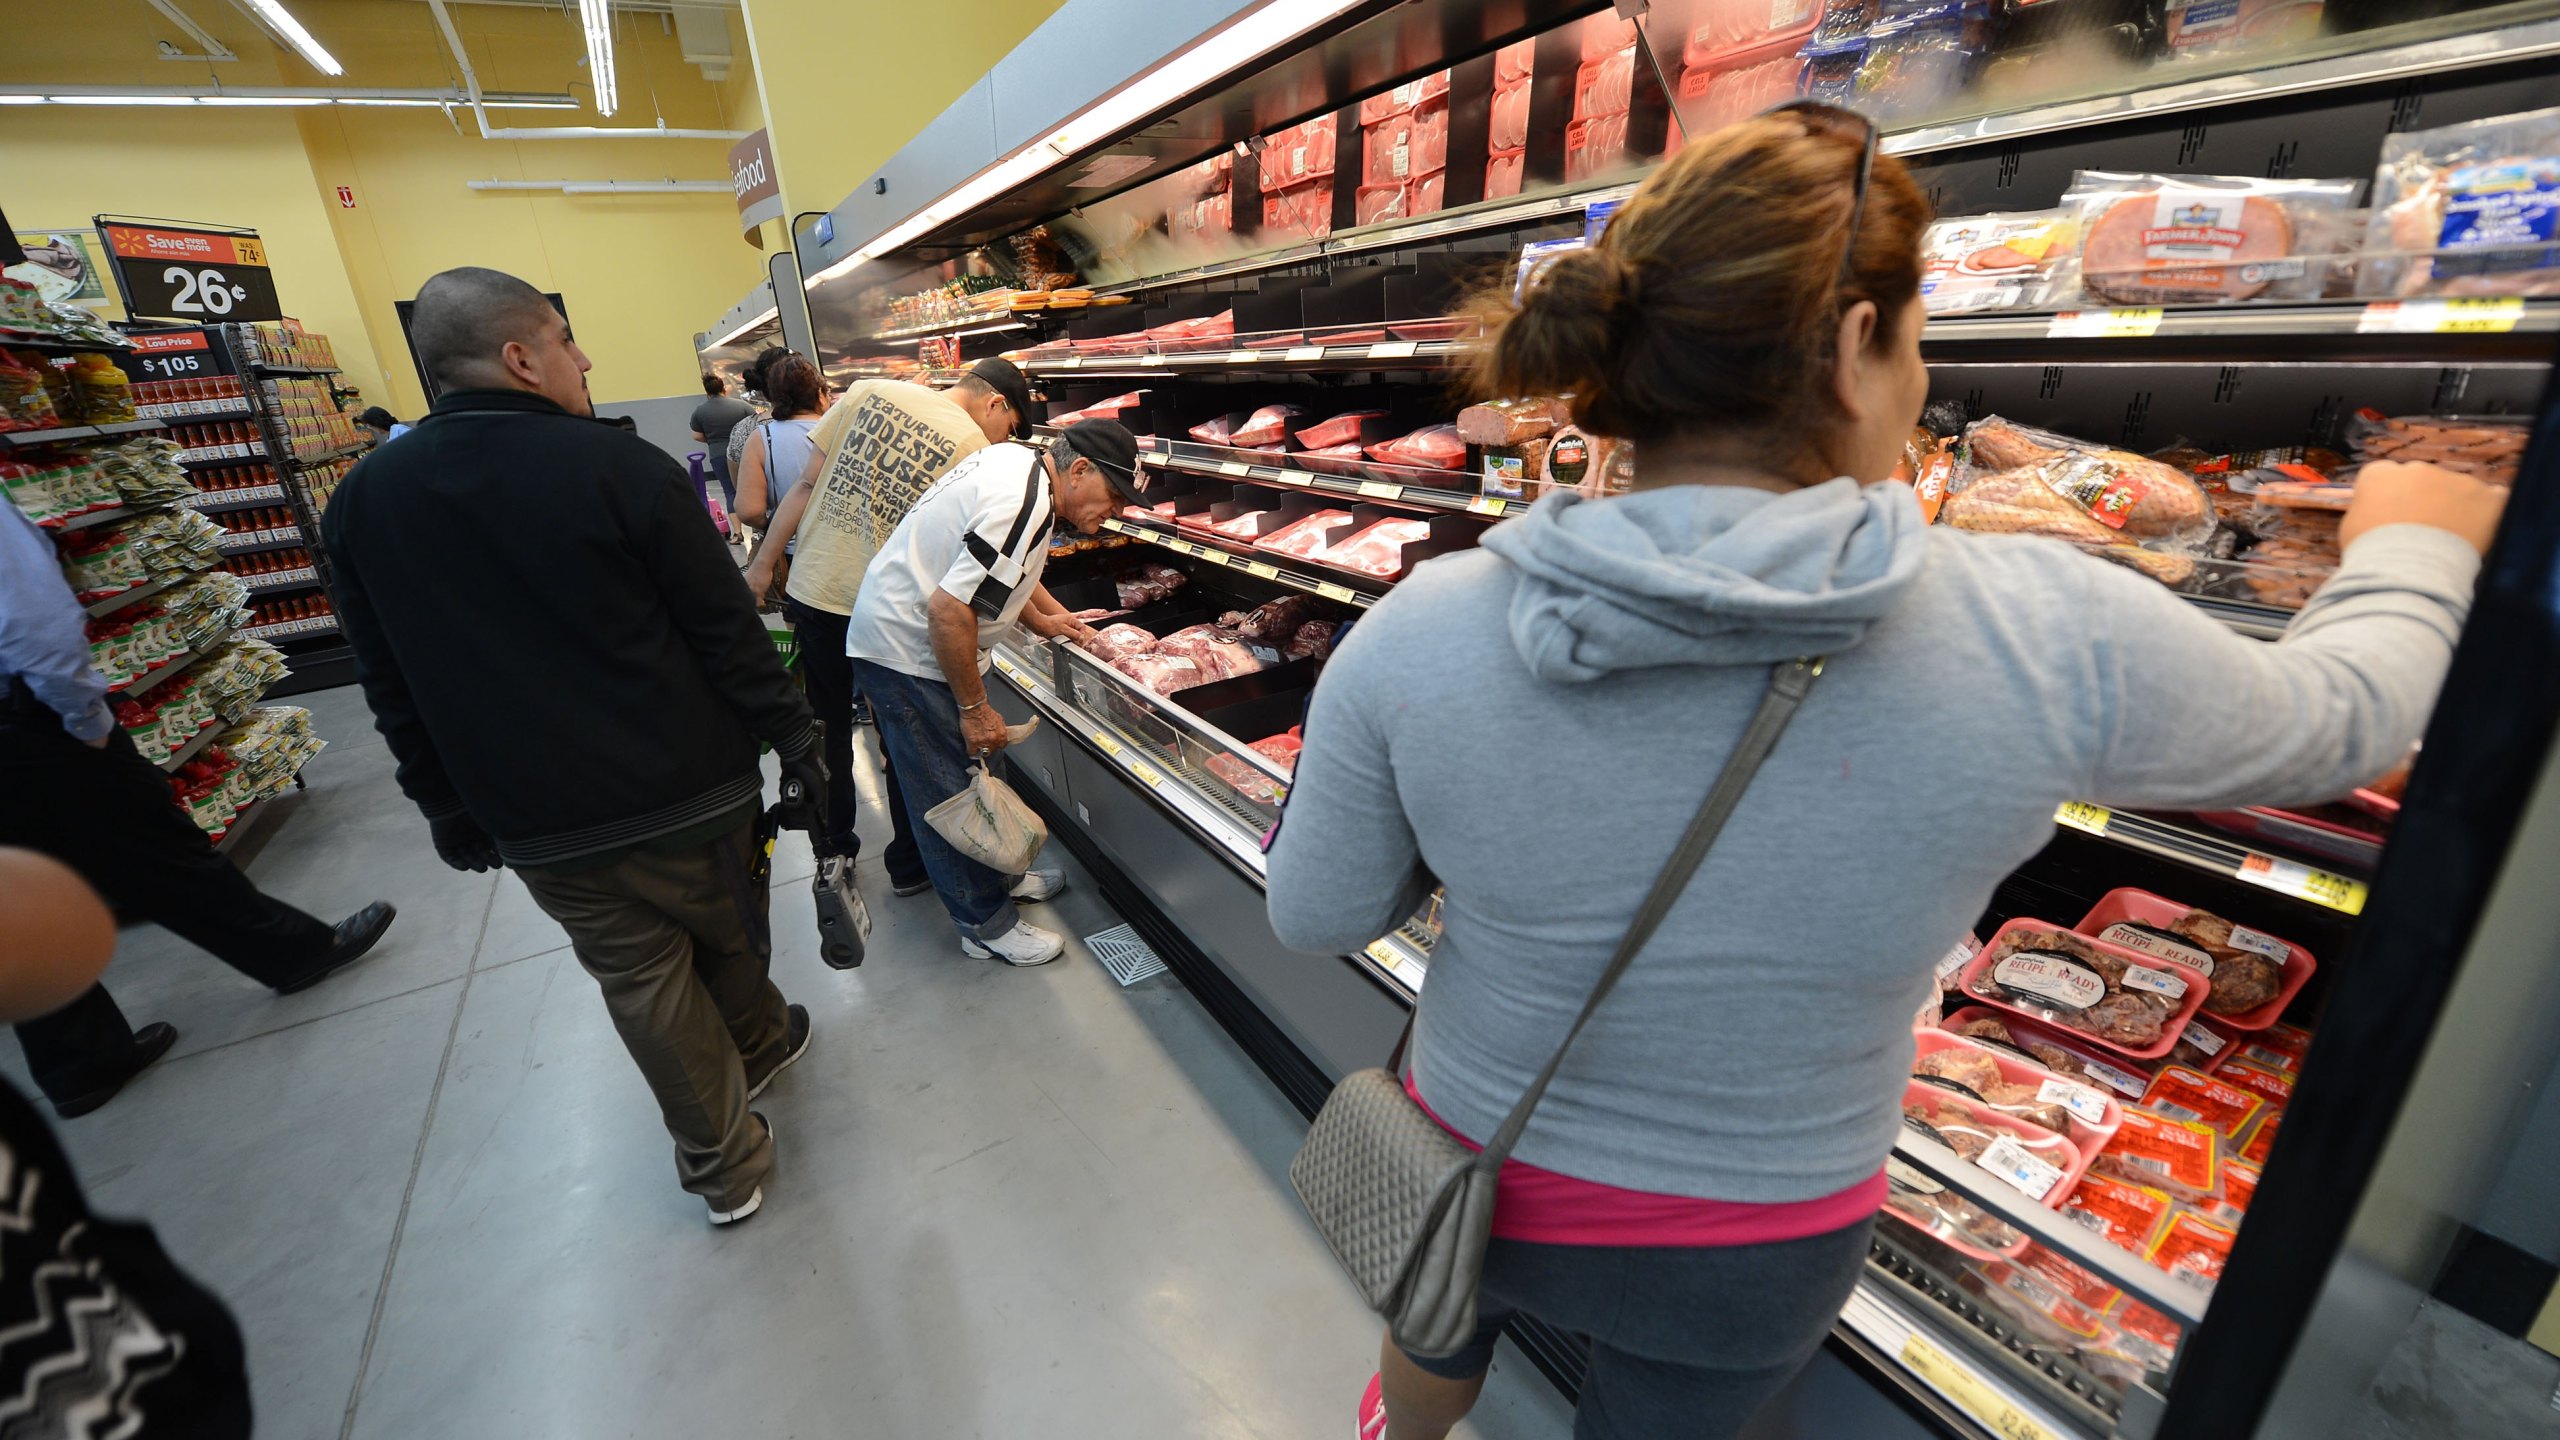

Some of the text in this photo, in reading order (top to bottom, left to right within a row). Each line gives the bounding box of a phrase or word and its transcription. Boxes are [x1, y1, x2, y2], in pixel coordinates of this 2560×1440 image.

[146, 234, 185, 249] Save
[184, 237, 207, 246] even
[186, 244, 212, 252] more
[2145, 229, 2242, 245] FARMER JOHN
[145, 337, 192, 348] Low Price
[855, 407, 947, 472] MODEST
[843, 430, 936, 493] MOUSE
[817, 510, 863, 538] SATURDAY
[823, 492, 895, 535] FROST AMPHITHEA
[2112, 929, 2208, 970] RECIPE READY
[2009, 960, 2099, 991] RECIPE READY
